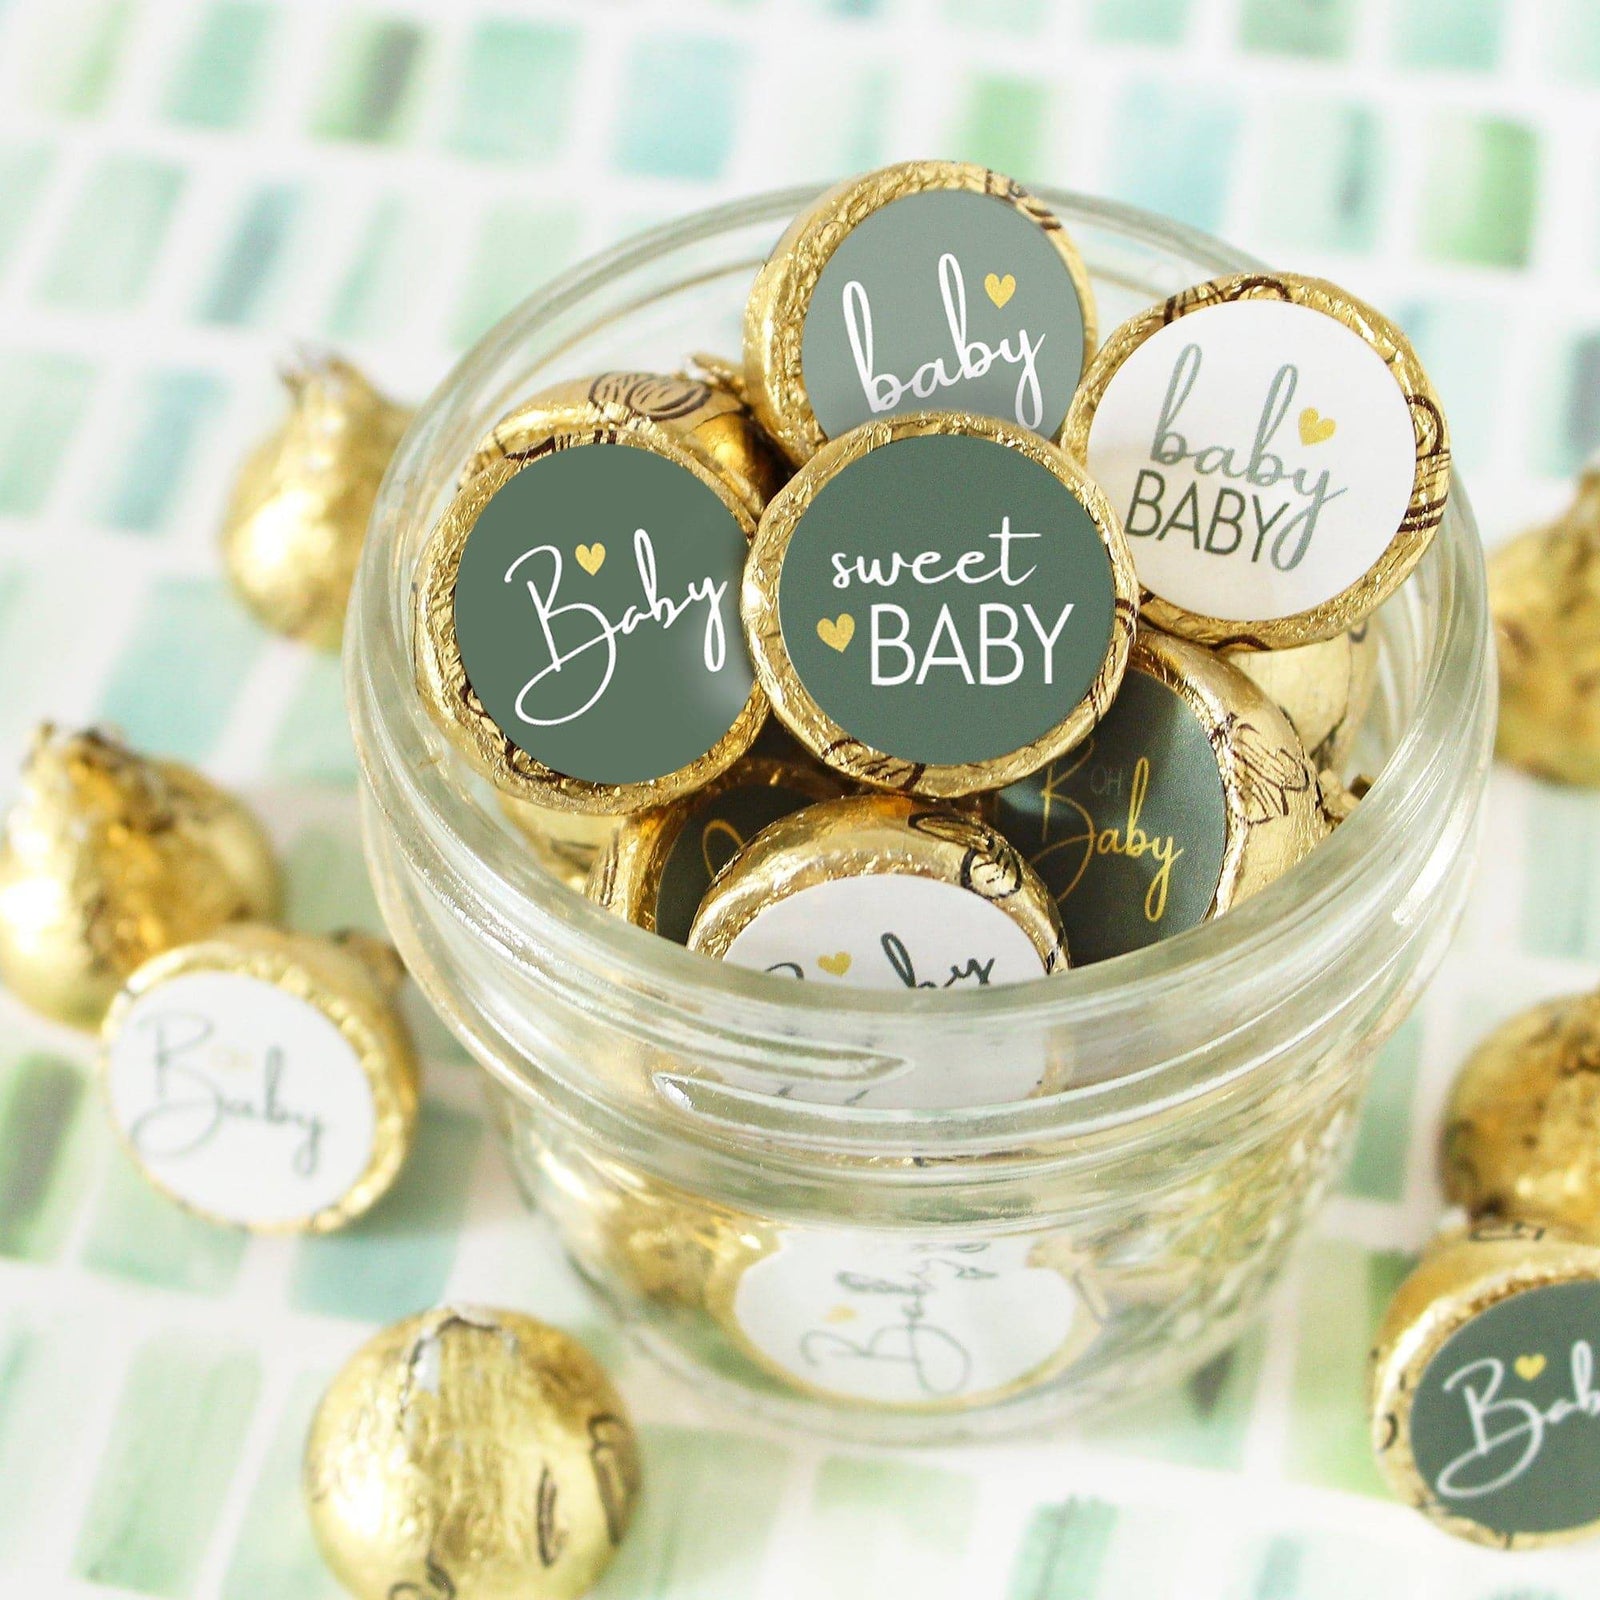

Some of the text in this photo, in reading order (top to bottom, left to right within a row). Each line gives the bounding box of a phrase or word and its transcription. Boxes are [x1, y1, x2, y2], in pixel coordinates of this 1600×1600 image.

[842, 253, 1046, 430] baby
[1124, 469, 1290, 563] BABY
[1150, 343, 1348, 572] baby
[504, 528, 728, 726] Baby
[831, 516, 1041, 588] sweet
[870, 603, 1074, 686] BABY
[129, 1008, 337, 1179] Baby
[1436, 1339, 1600, 1498] Bab
